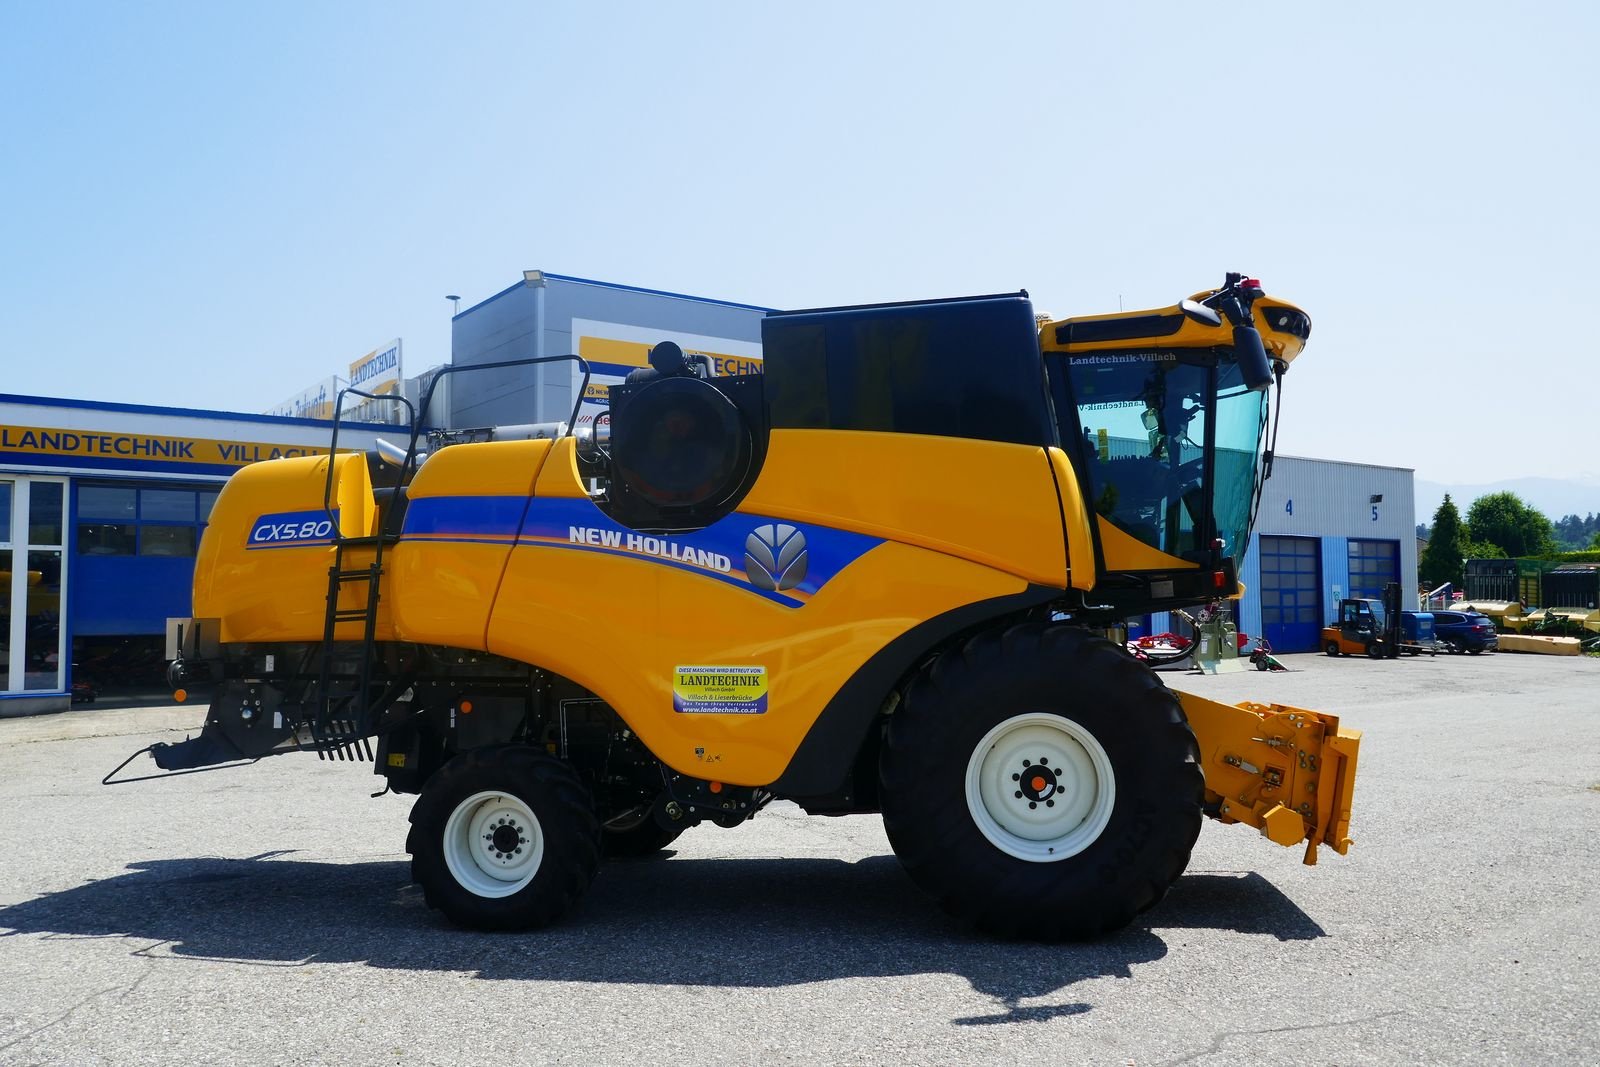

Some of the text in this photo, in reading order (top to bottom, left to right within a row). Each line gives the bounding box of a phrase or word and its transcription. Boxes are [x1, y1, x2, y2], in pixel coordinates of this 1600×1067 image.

[350, 346, 397, 387] LANDTECHNIK
[1069, 353, 1177, 365] Landtechnik-Villach
[2, 429, 195, 458] LANDTECHNIK
[1285, 499, 1293, 516] 4
[1372, 508, 1378, 521] 5
[254, 521, 332, 541] CX5.80
[569, 526, 731, 573] NEW HOLLAND
[680, 675, 760, 686] LANDTECHNIK
[682, 706, 757, 714] www.landtechnik.co.at
